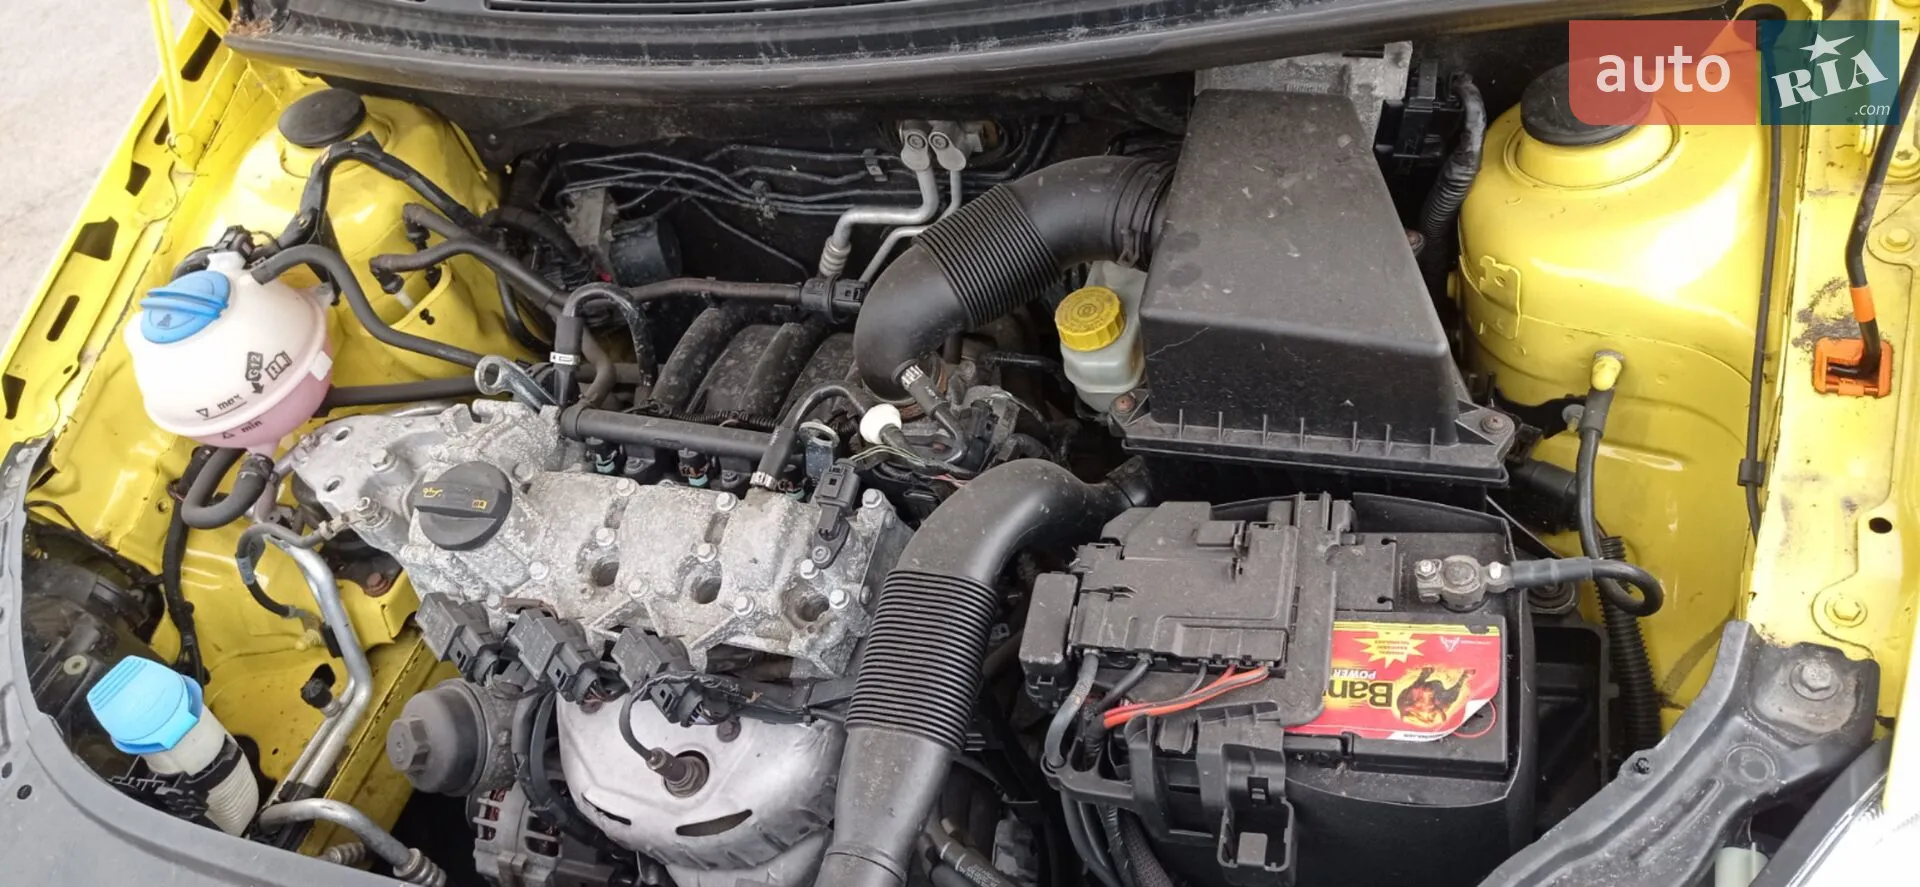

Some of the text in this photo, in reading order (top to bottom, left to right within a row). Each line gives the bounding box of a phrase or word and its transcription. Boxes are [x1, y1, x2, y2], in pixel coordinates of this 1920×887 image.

[248, 354, 261, 379] G12
[241, 420, 262, 433] min
[1333, 669, 1376, 680] POWER
[1323, 680, 1393, 707] Ban
